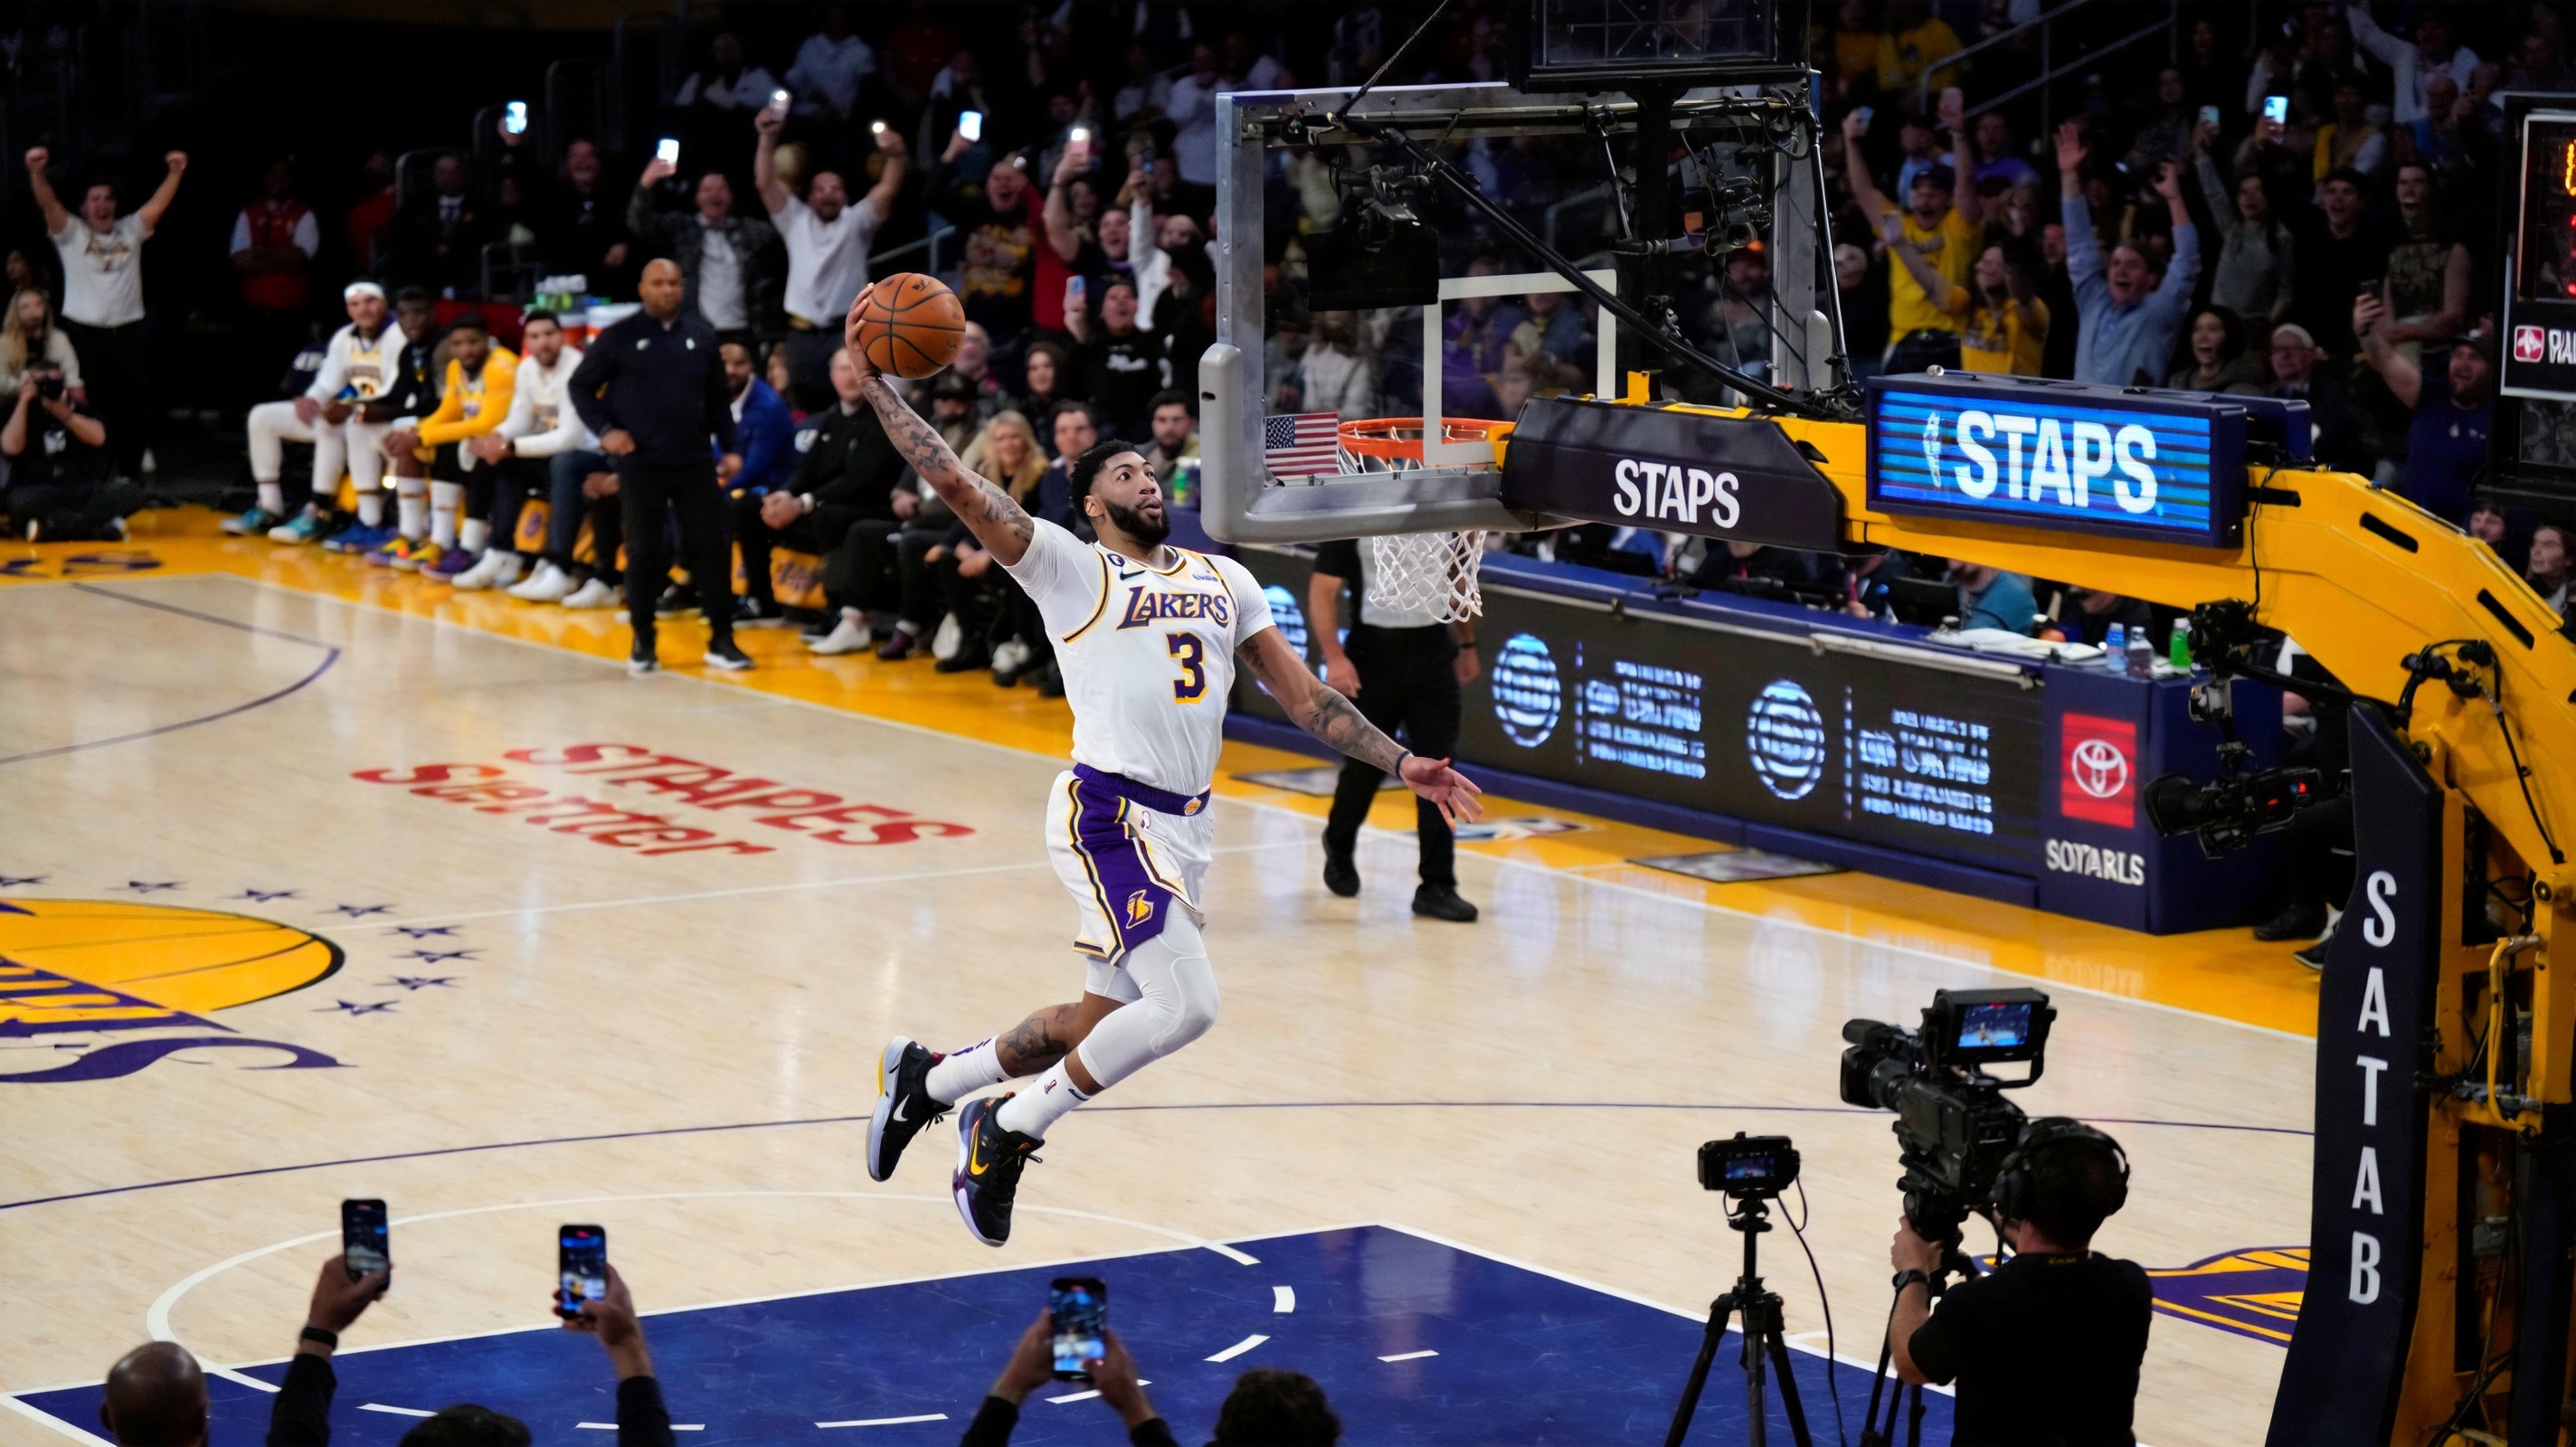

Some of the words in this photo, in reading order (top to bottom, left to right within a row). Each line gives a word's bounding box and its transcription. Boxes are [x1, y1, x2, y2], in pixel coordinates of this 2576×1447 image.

[1614, 459, 1740, 529] STAPS
[1955, 410, 2157, 514] STAPS
[1165, 631, 1209, 705] 3
